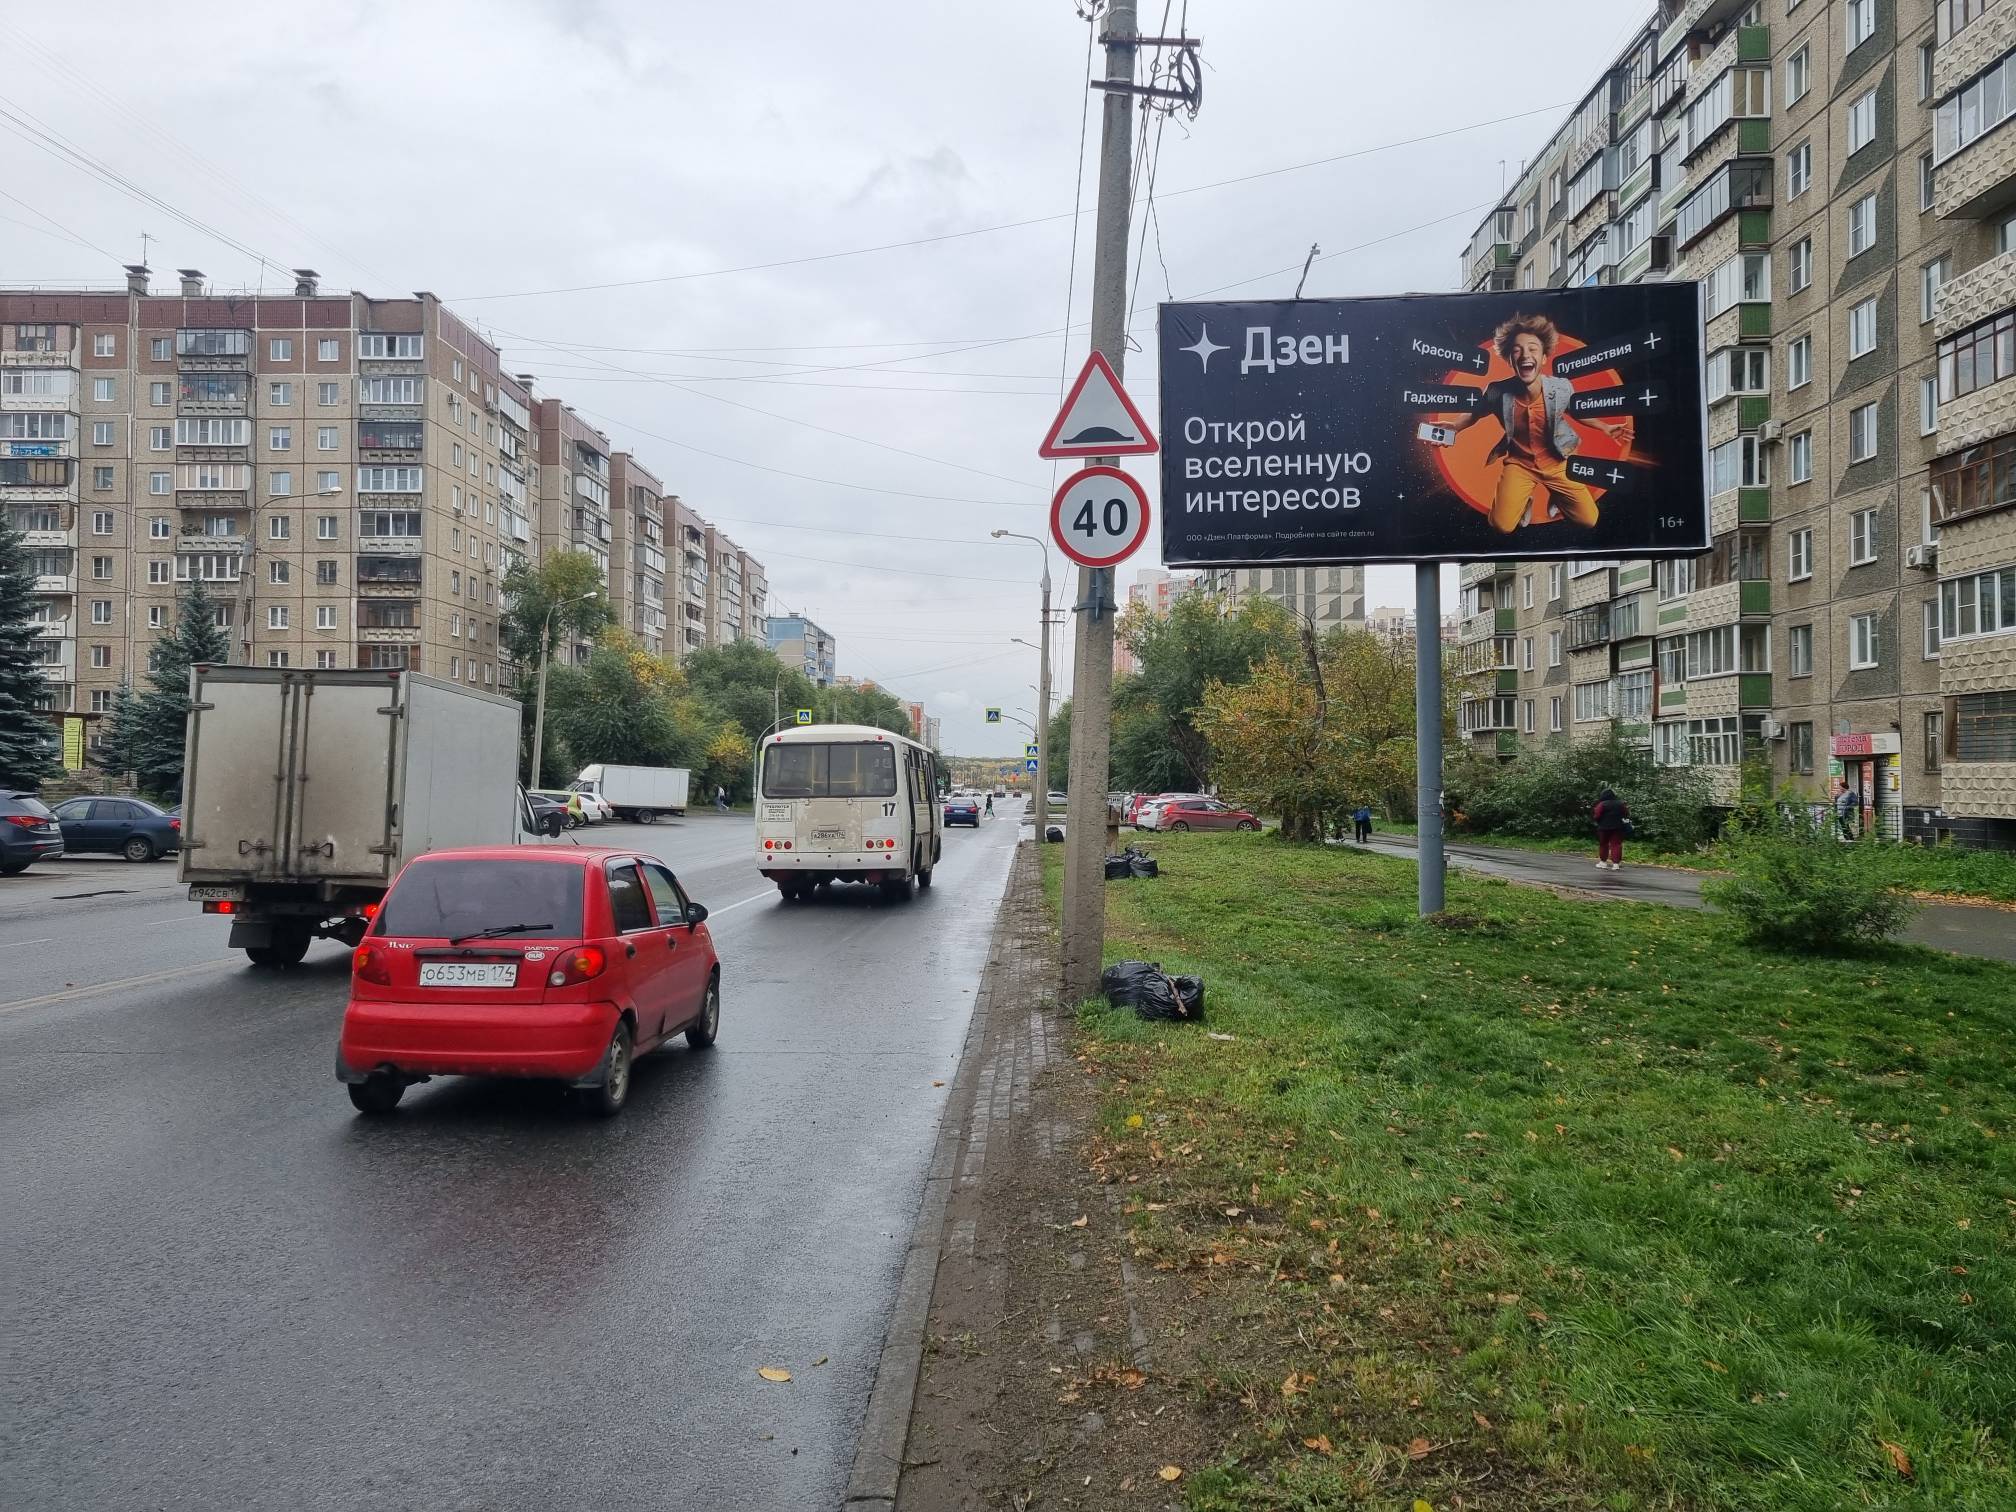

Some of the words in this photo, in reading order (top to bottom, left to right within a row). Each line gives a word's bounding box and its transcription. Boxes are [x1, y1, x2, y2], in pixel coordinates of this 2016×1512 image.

[1241, 326, 1350, 374] Дзен
[1412, 339, 1464, 362] Красота
[1557, 343, 1632, 373] Путешествия
[1403, 390, 1458, 405] Гаджеты
[1575, 394, 1626, 411] Гейминг
[1184, 413, 1306, 449] Открой
[1185, 452, 1371, 481] вселенную
[1572, 463, 1595, 477] Еда
[1186, 487, 1361, 518] интересов
[1073, 498, 1128, 537] 40
[1658, 516, 1685, 528] 16+
[1275, 531, 1315, 540] Подробнее
[882, 803, 896, 817] 17
